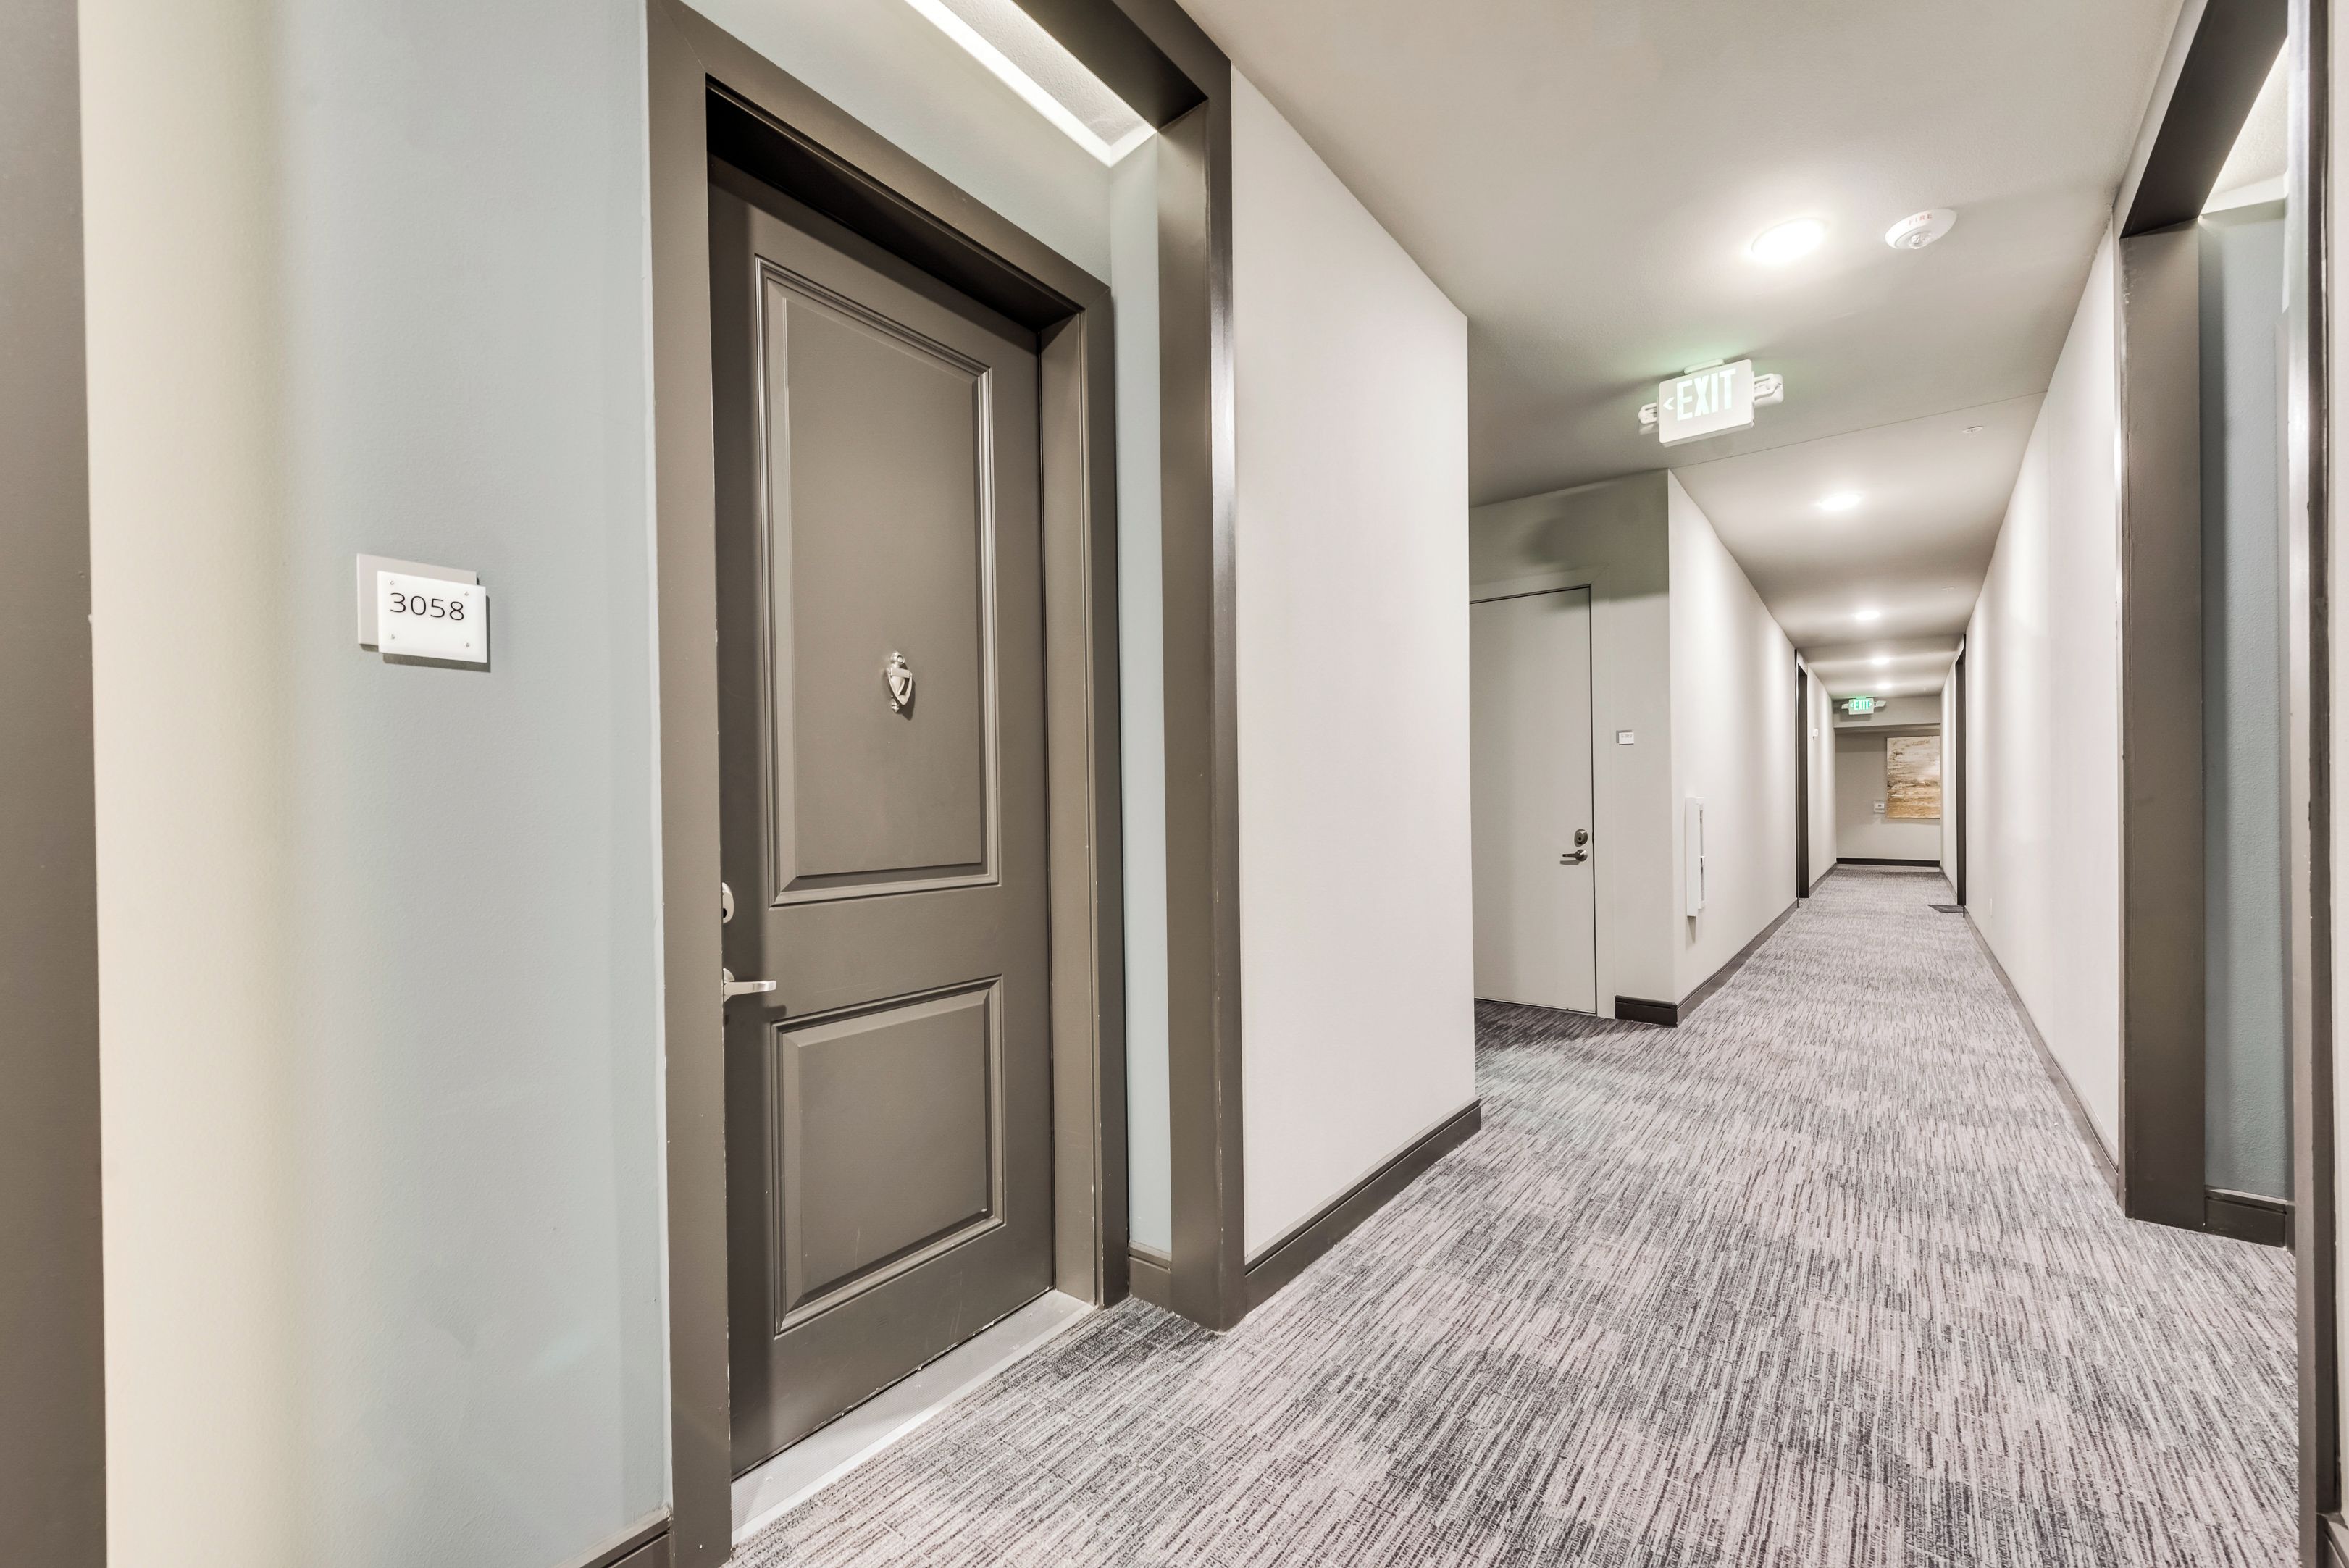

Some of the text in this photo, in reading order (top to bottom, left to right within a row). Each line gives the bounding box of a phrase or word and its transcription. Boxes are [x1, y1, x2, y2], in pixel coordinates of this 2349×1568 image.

[1909, 213, 1933, 225] FIRE
[1676, 368, 1736, 422] EXIT
[390, 592, 464, 621] 3058
[1854, 699, 1869, 710] EXIT
